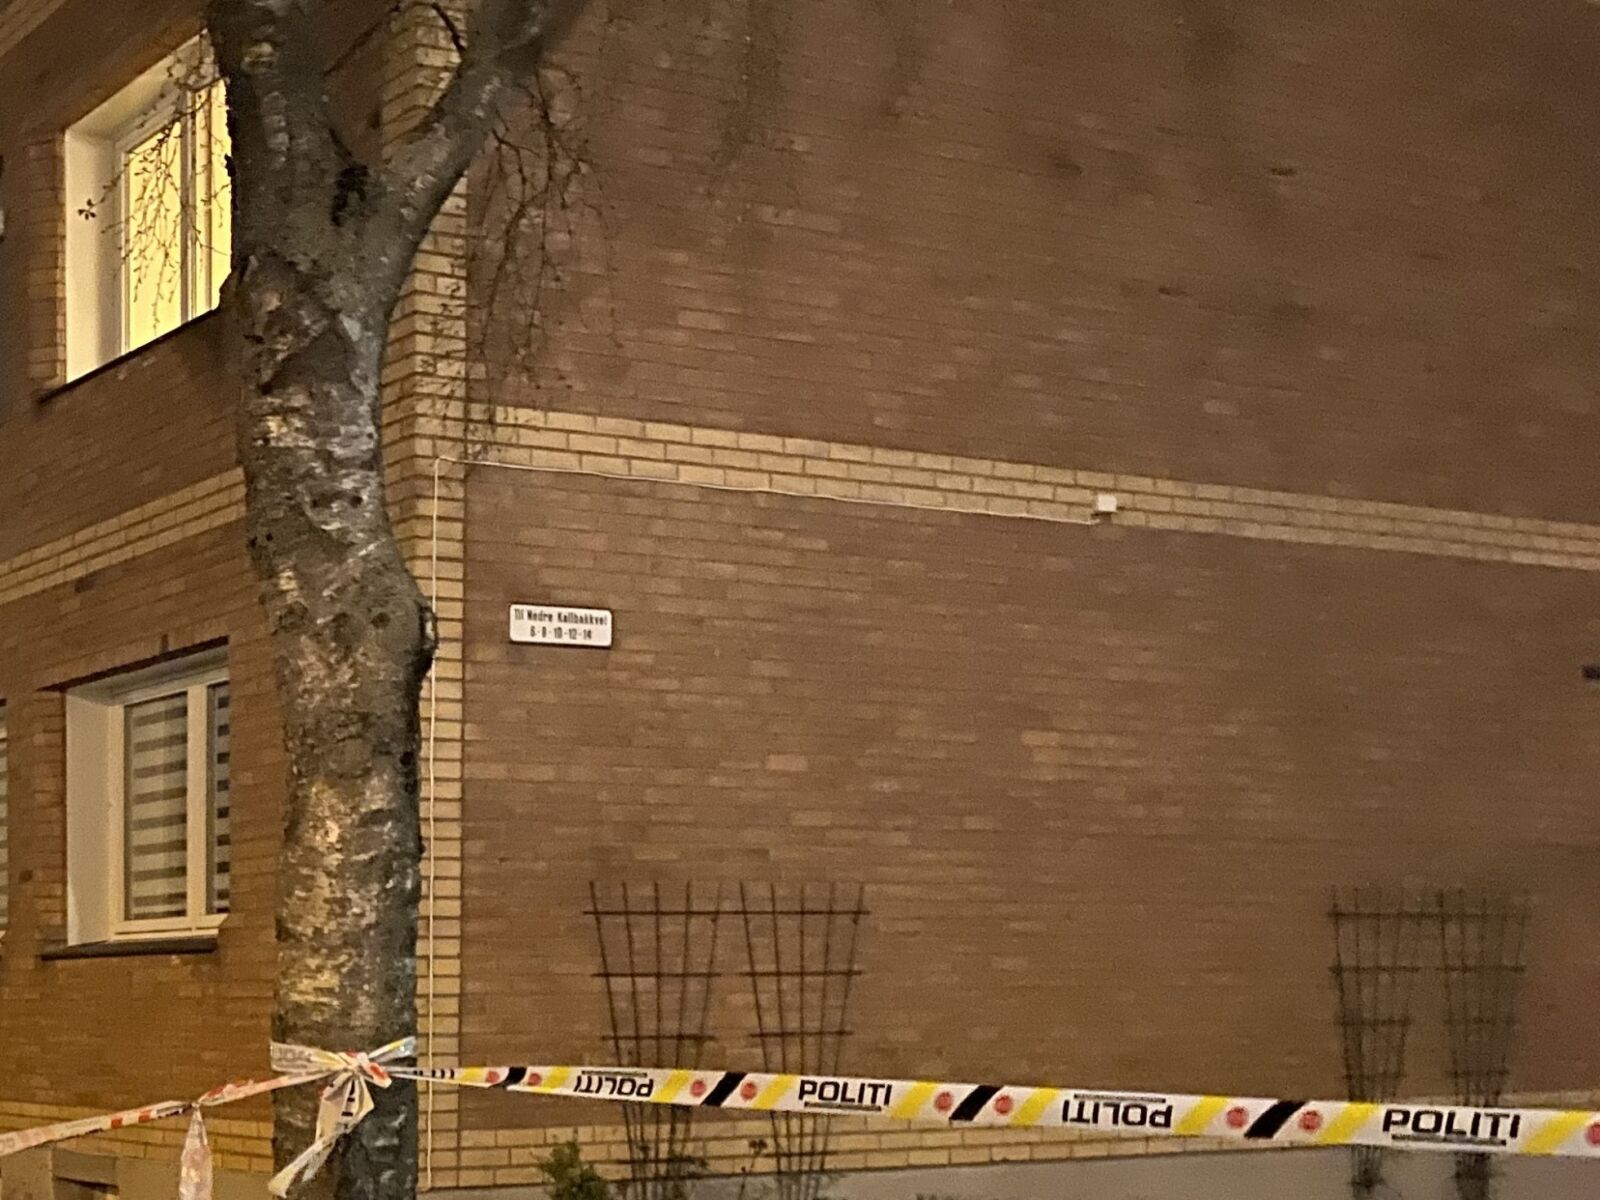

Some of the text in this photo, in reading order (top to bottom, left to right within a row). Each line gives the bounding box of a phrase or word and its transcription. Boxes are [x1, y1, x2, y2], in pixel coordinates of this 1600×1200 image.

[527, 609, 553, 623] Nedre
[573, 1074, 654, 1098] POLITI
[798, 1079, 892, 1106] POLITI
[1061, 1098, 1174, 1129] POLITI
[1382, 1108, 1521, 1139] POLITI
